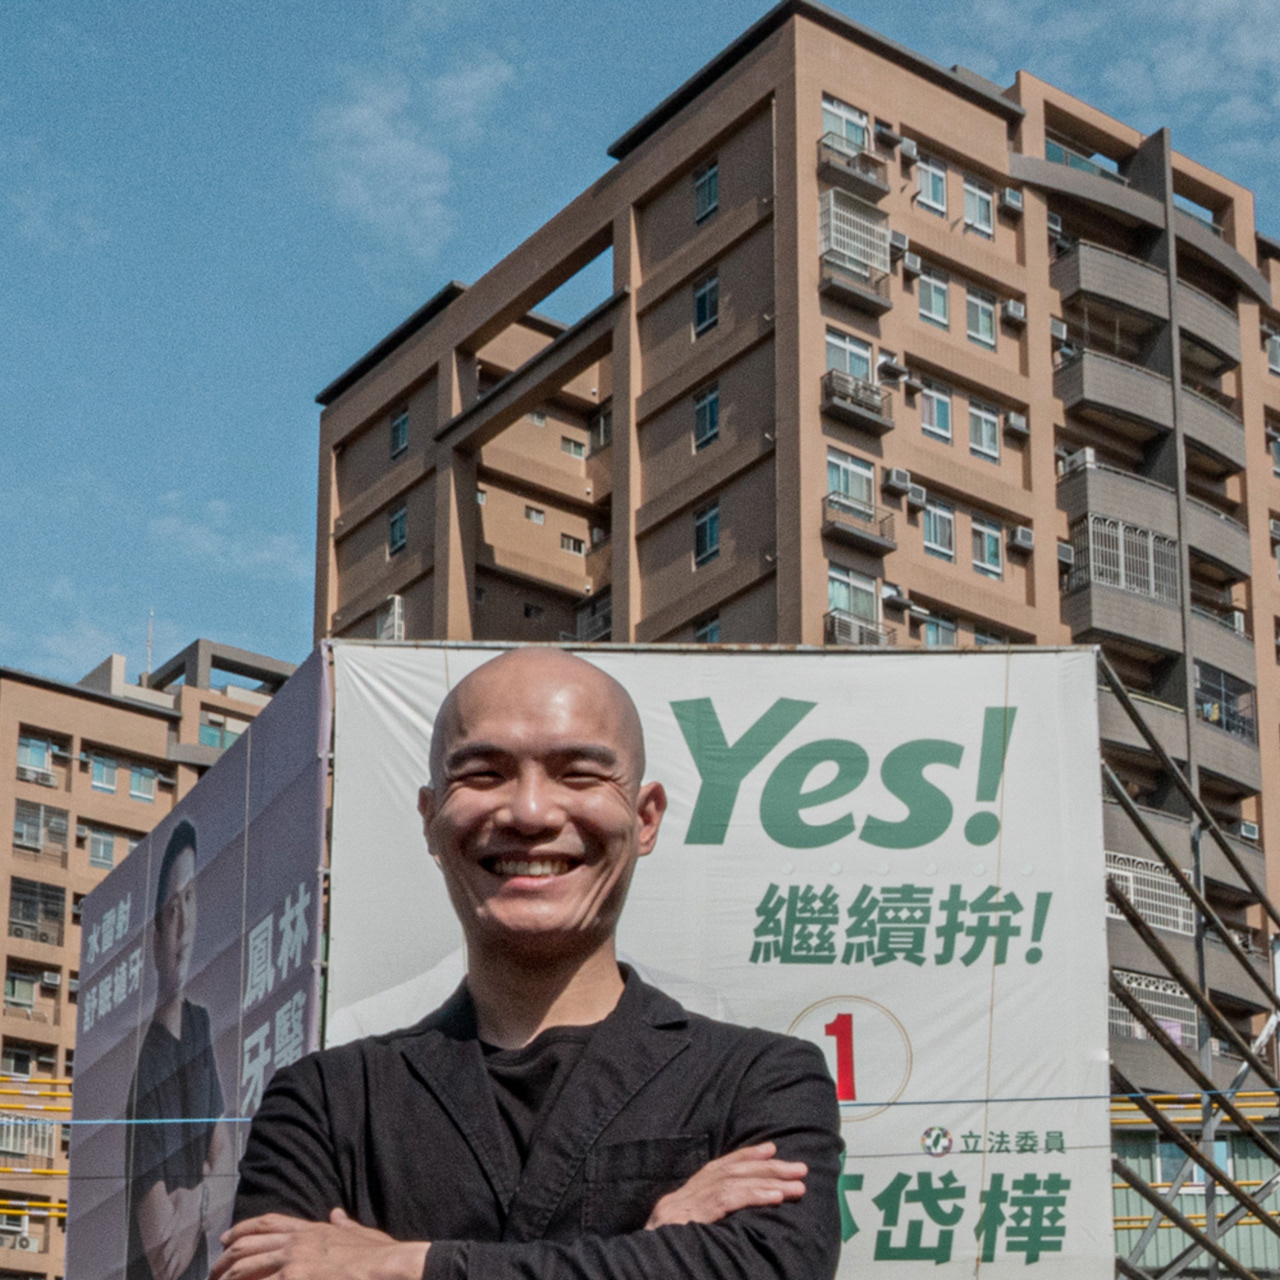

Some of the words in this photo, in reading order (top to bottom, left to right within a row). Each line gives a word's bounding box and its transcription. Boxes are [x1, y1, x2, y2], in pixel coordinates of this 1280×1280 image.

[669, 697, 1017, 850] Yes!
[749, 882, 1052, 966] 繼續拚!
[824, 1012, 857, 1102] 1
[960, 1130, 1066, 1154] 立法委員
